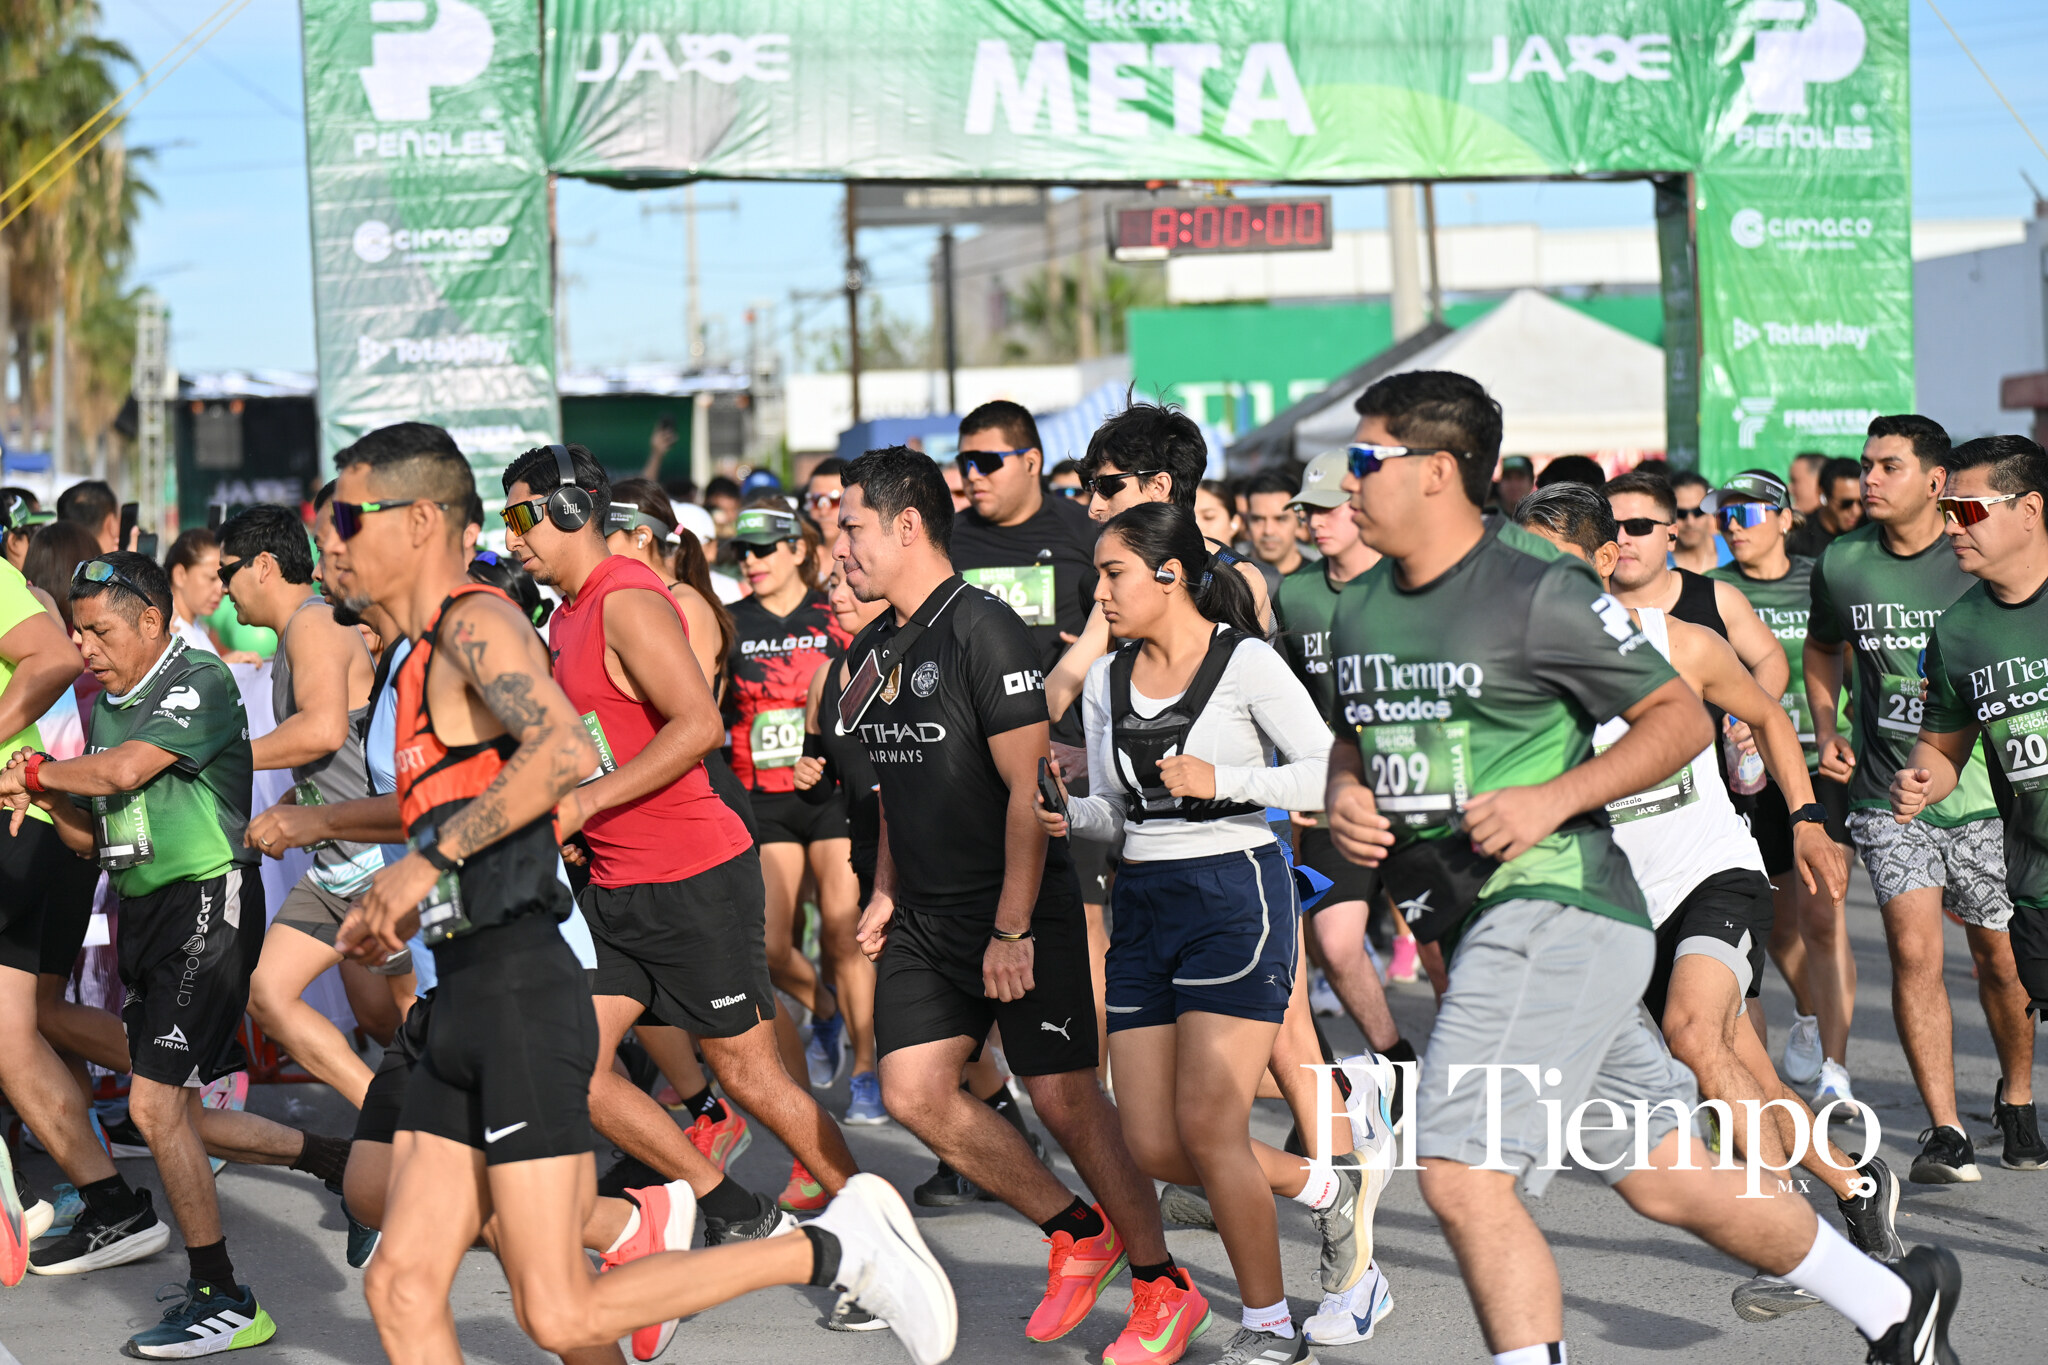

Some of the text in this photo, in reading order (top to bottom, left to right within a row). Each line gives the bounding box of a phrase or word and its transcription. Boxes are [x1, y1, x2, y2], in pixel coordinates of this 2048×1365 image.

[964, 40, 1316, 136] META
[1762, 319, 1870, 351] Totalplay
[563, 502, 581, 515] JBL
[975, 582, 1027, 607] 06
[1850, 604, 1946, 631] El Tiem
[741, 635, 828, 654] GALGOS
[1302, 632, 1323, 657] El
[1859, 632, 1931, 651] de tod
[1305, 659, 1329, 674] de
[1338, 653, 1484, 698] El Tiempo
[1968, 665, 1998, 700] El
[584, 716, 595, 726] 107
[1345, 695, 1453, 725] de todos
[1887, 693, 1925, 724] 28
[1977, 702, 2006, 721] de
[857, 722, 947, 744] TIHAD
[869, 750, 924, 763] AIRWAYS
[1371, 752, 1430, 796] 209
[1681, 766, 1692, 795] MED
[1608, 797, 1642, 809] Gonzalo
[132, 807, 150, 856] MEDALLA
[711, 992, 747, 1010] Wilson
[154, 1038, 190, 1052] PIRMA
